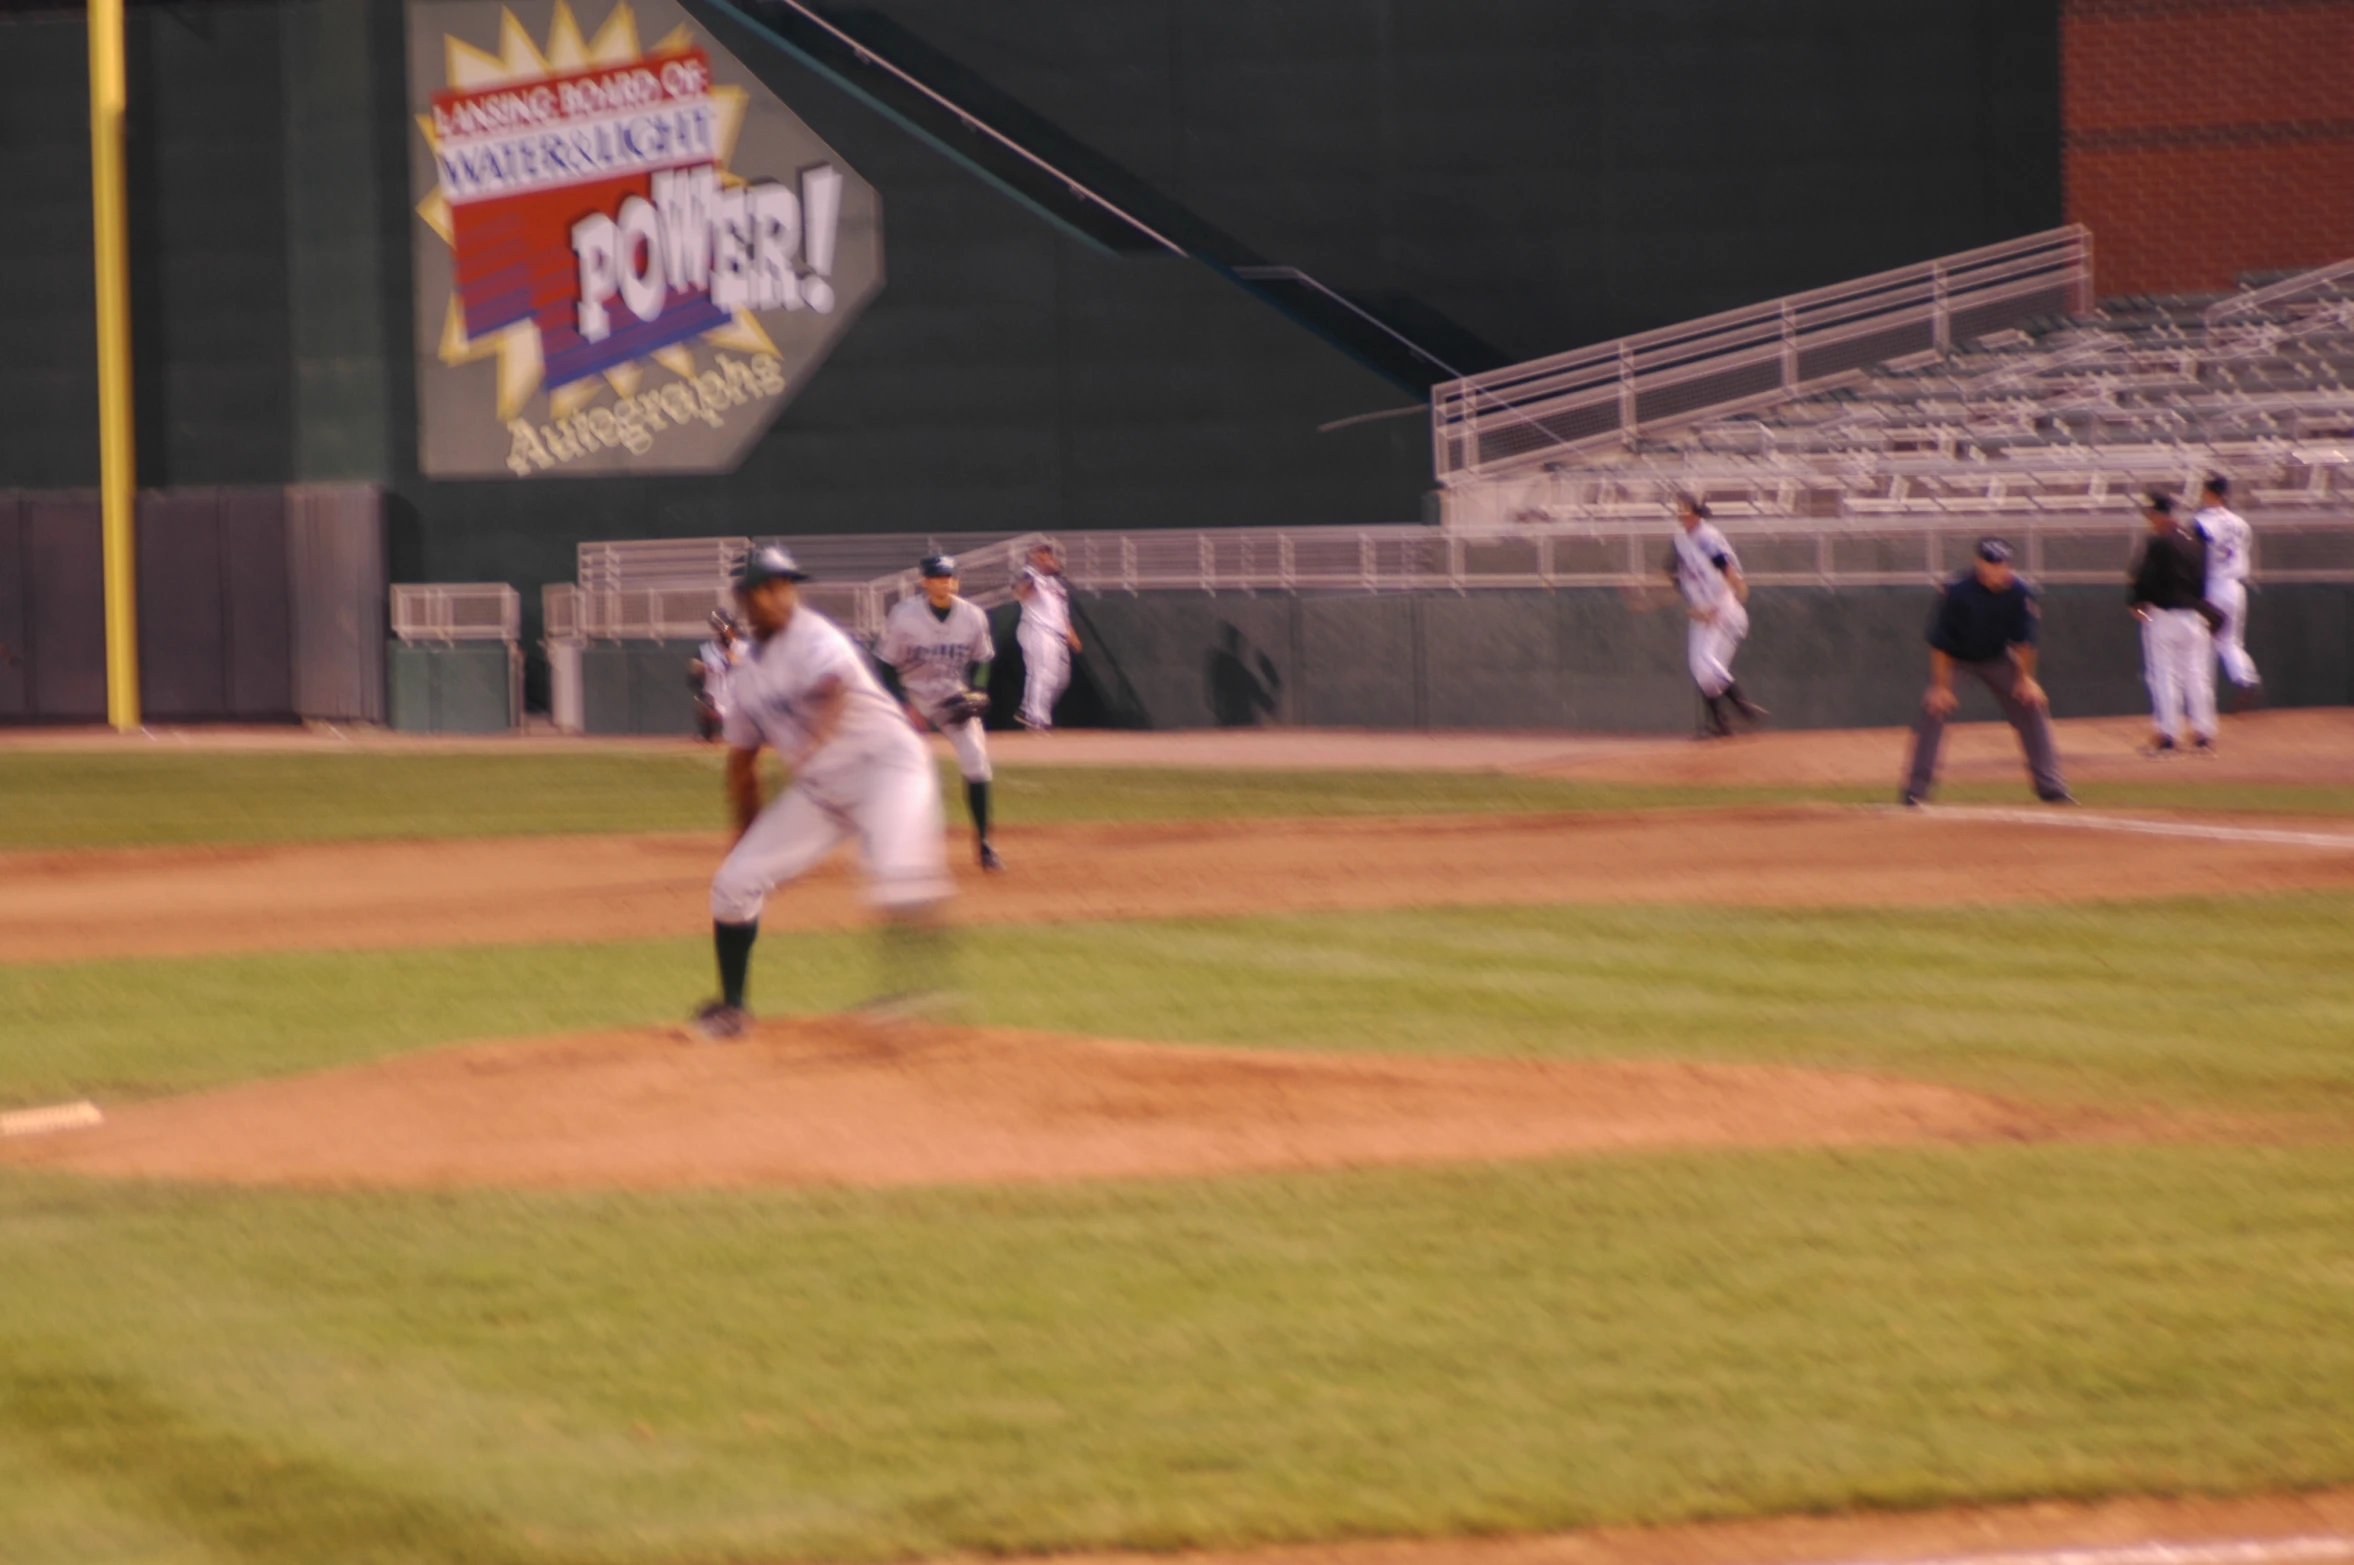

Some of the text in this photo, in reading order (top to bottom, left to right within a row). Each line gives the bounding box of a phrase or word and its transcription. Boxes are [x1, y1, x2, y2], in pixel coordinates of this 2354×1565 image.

[433, 58, 709, 139] LANSING BOARD OF
[571, 163, 842, 343] POWER!
[505, 353, 786, 477] Autographs
